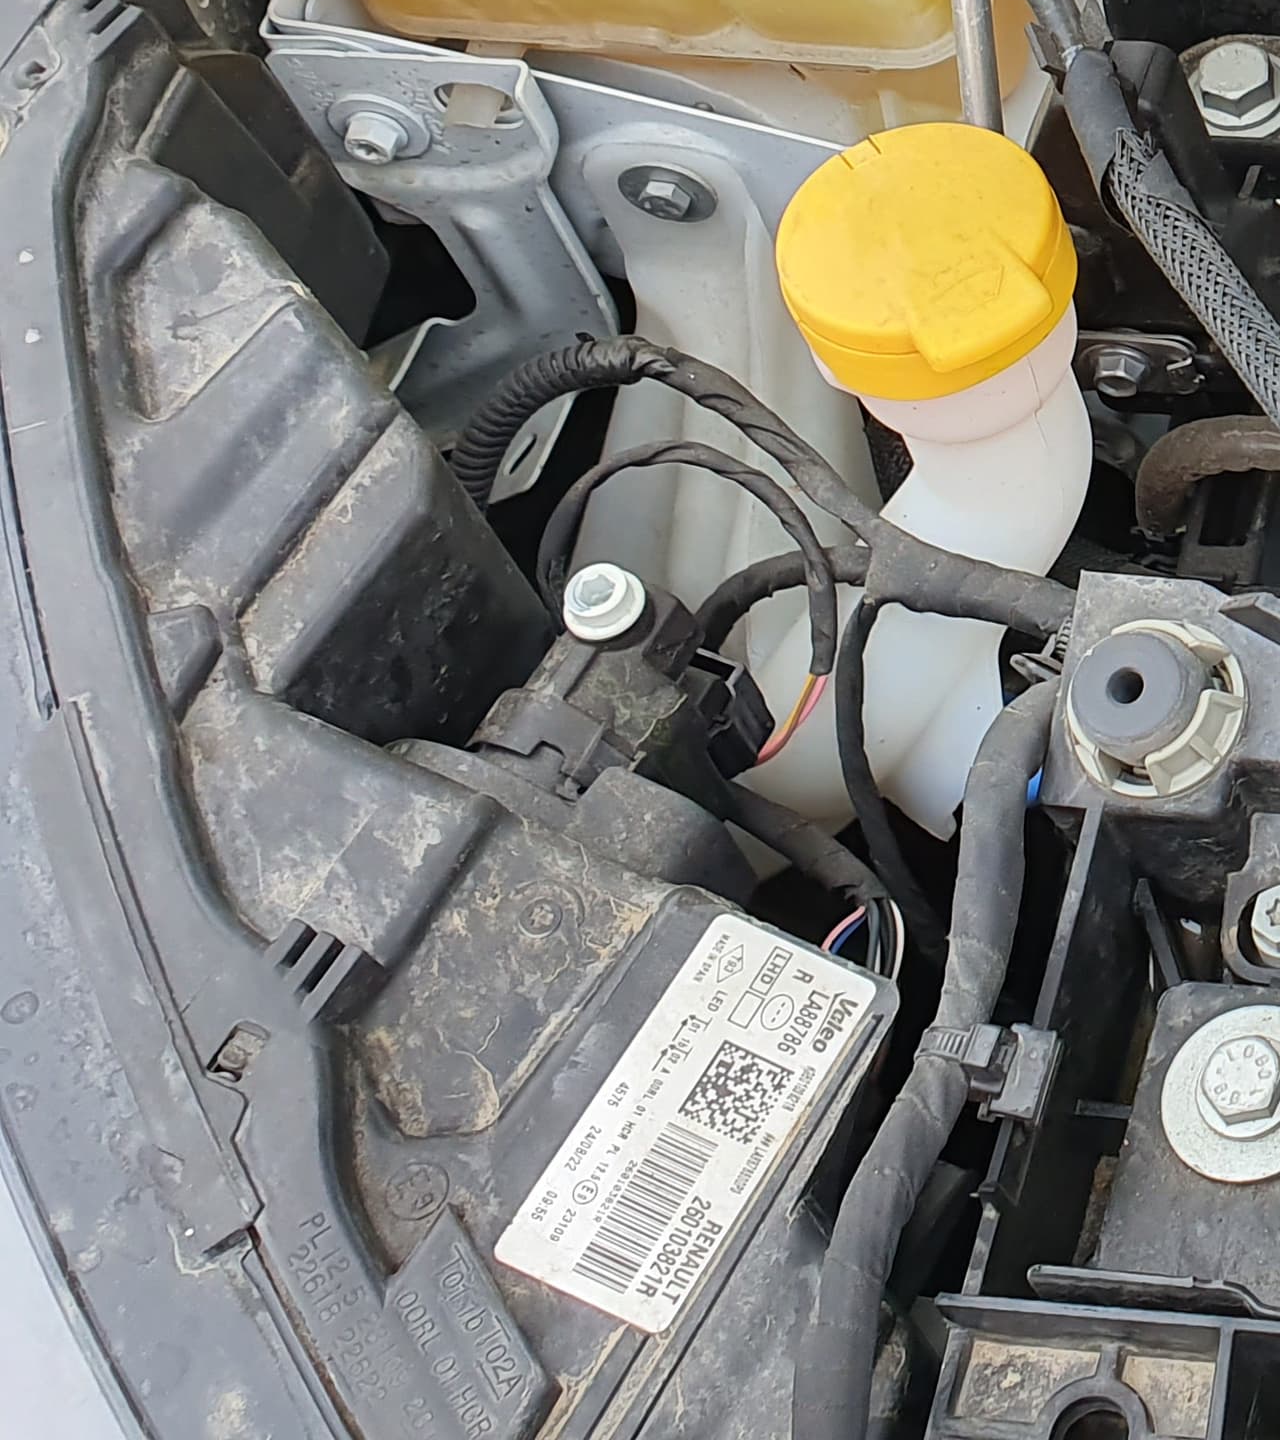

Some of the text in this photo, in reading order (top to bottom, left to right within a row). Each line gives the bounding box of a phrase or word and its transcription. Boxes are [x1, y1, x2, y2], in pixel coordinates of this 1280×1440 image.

[711, 932, 731, 953] MADE
[691, 961, 712, 983] SPAIN
[757, 951, 787, 986] LHD
[791, 968, 813, 984] R
[705, 989, 727, 1013] LED
[775, 989, 830, 1056] LA88786
[529, 1081, 631, 1222] 4575 24/08/22 09:55
[590, 1158, 638, 1224] 260103821R
[546, 1207, 577, 1243] 23109
[633, 1194, 712, 1300] 260103821R
[287, 1245, 339, 1323] 22618
[658, 1219, 723, 1306] RENAULT
